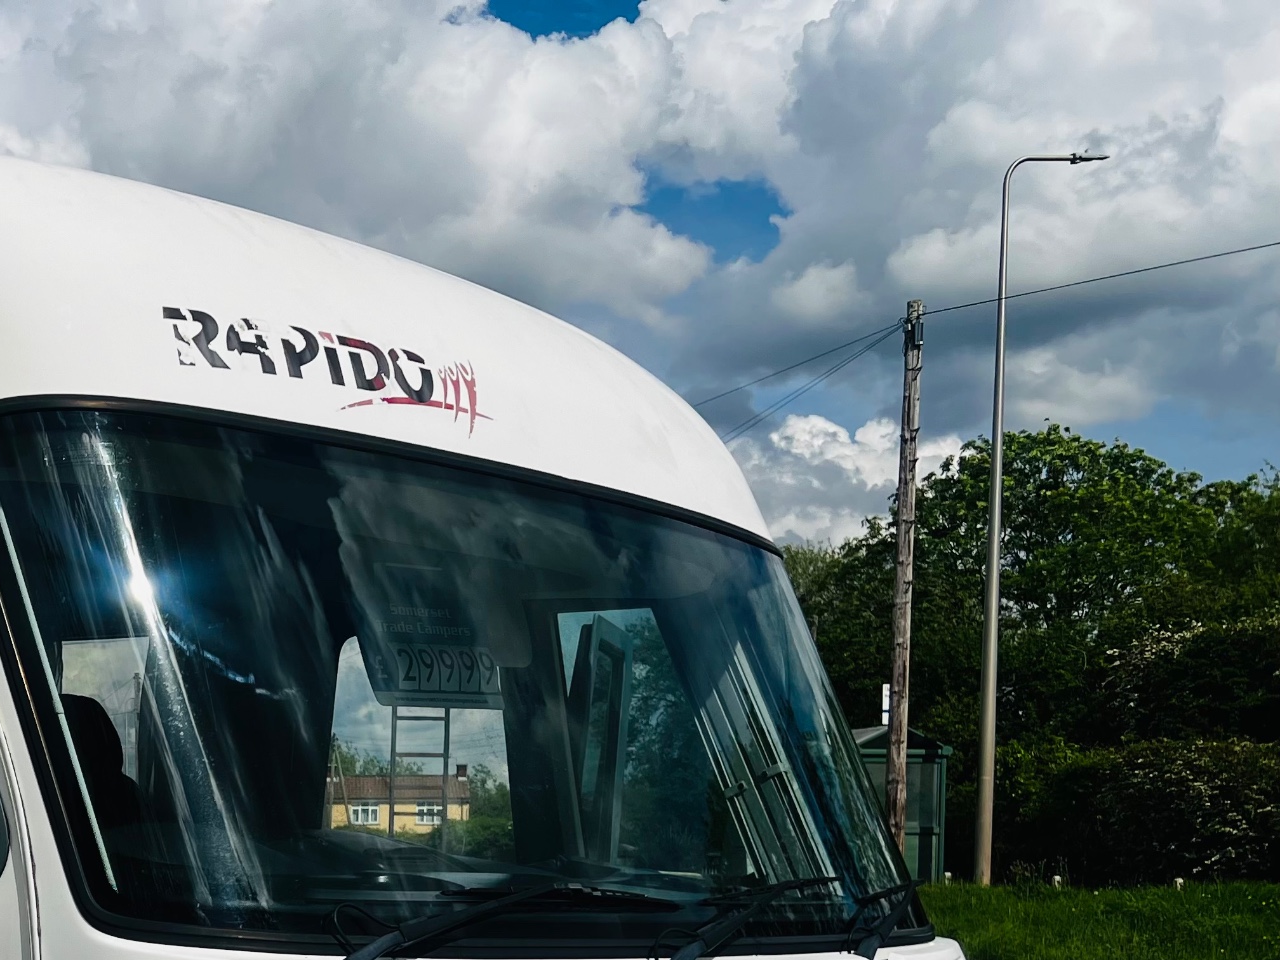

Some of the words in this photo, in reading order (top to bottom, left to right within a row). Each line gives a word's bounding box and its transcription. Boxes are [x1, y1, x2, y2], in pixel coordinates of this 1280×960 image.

[390, 603, 451, 619] Somerset
[376, 620, 414, 634] Trade
[417, 622, 471, 638] Campers
